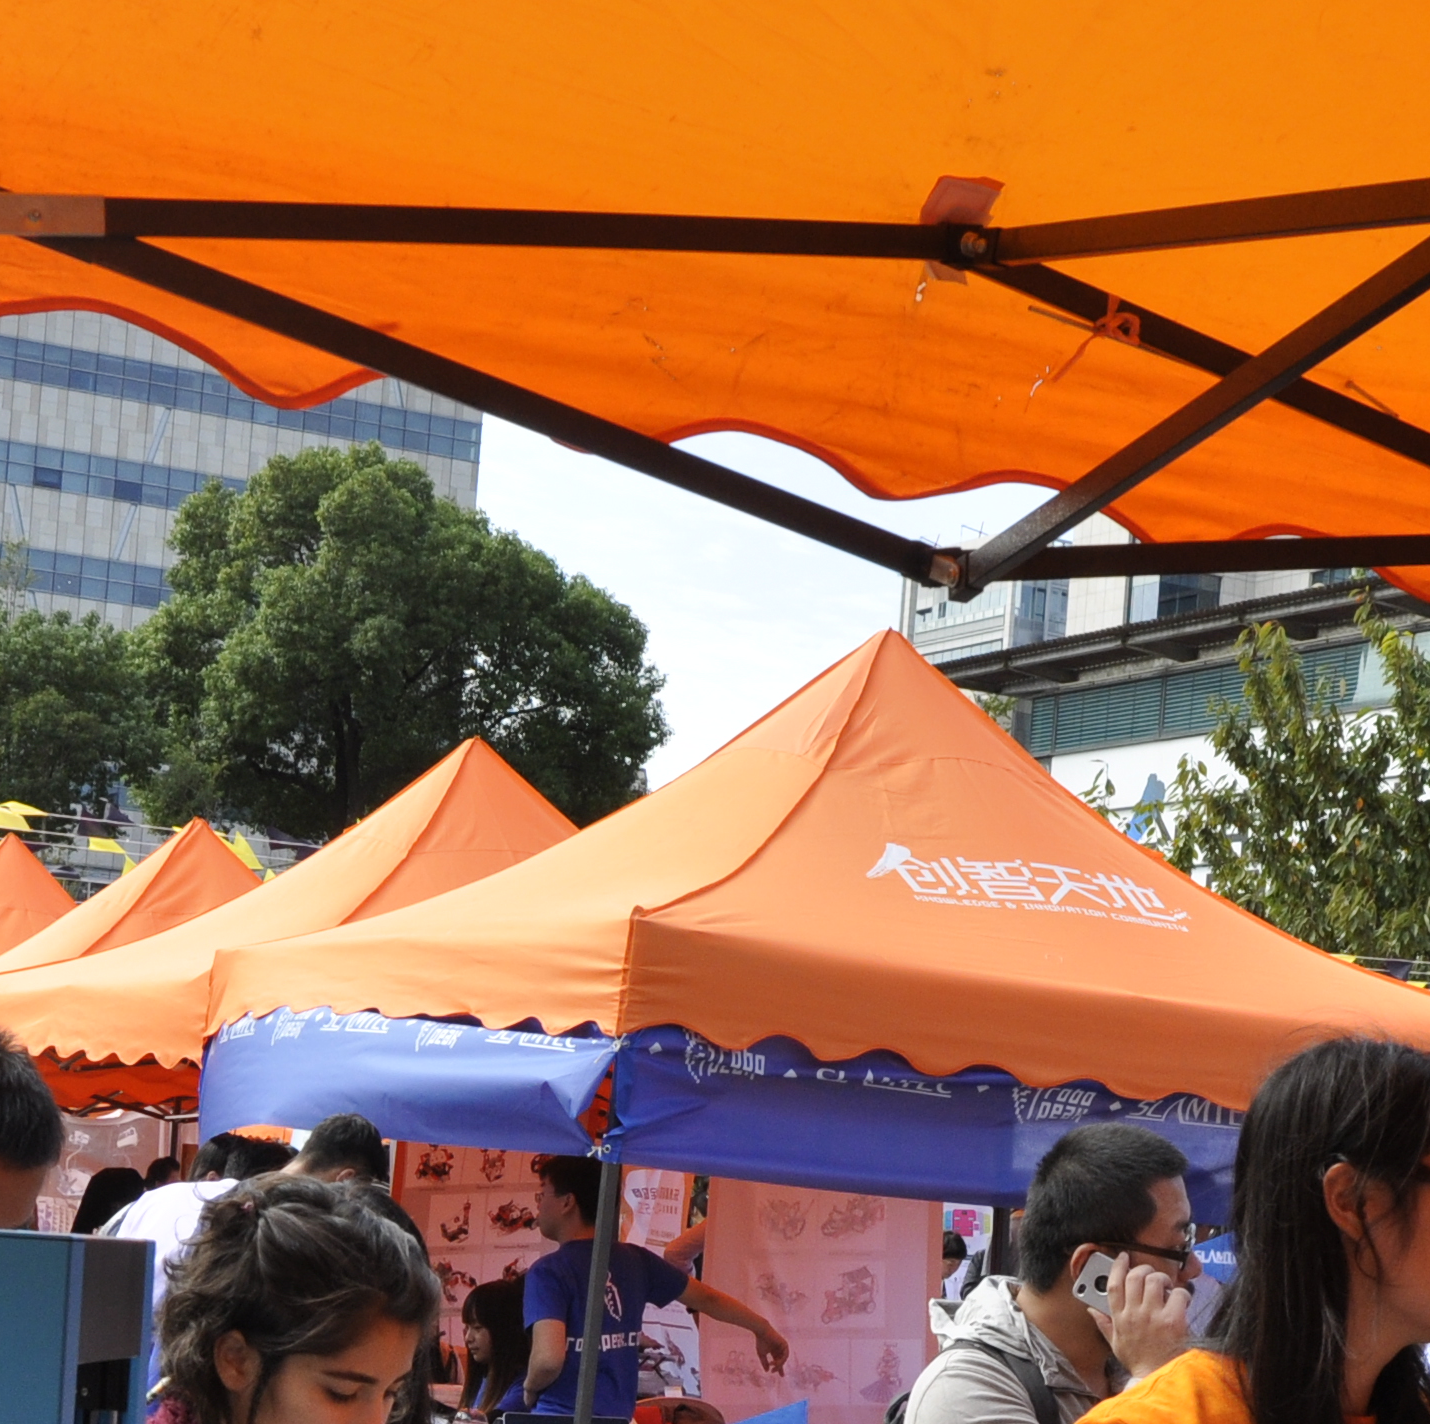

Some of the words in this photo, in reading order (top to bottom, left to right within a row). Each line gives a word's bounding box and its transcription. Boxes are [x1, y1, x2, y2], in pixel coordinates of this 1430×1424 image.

[895, 855, 1177, 922] 创智天地
[914, 894, 1001, 910] KNOWLEDGE
[1005, 901, 1017, 910] &
[1021, 902, 1107, 919] INNOVATION
[1110, 912, 1189, 933] COMMUNITY
